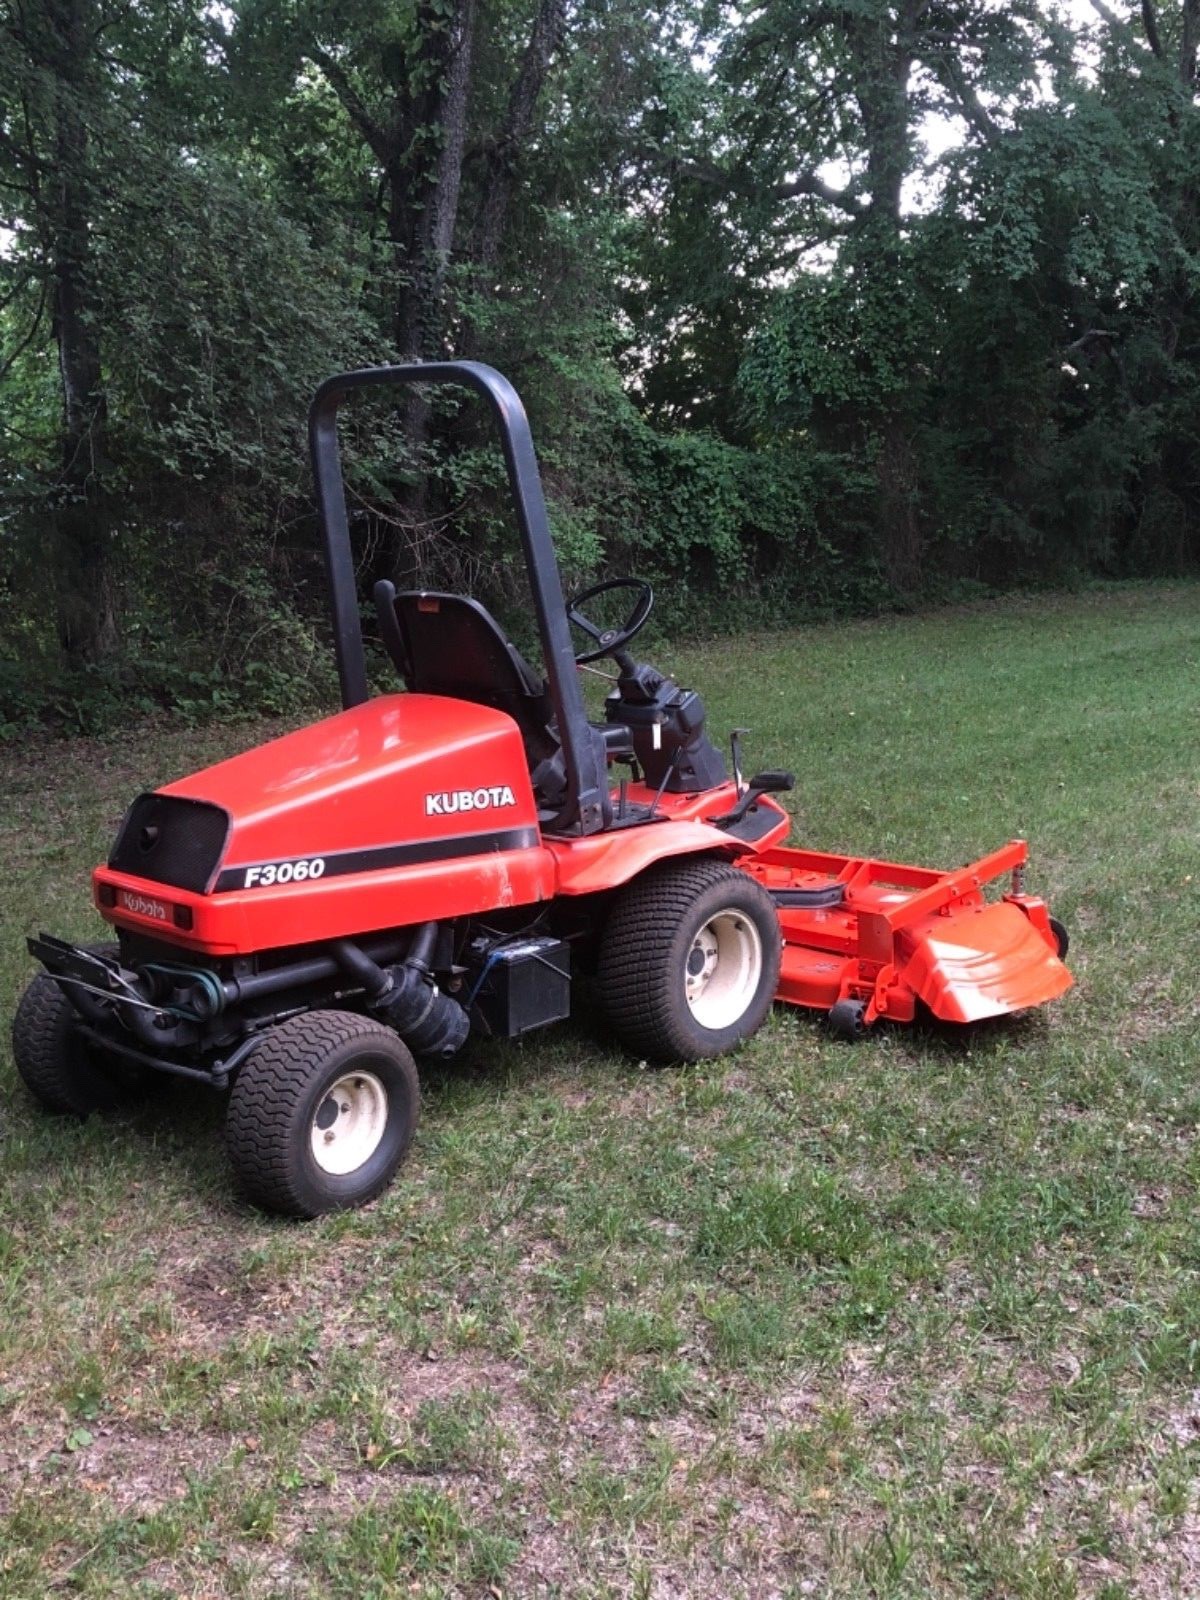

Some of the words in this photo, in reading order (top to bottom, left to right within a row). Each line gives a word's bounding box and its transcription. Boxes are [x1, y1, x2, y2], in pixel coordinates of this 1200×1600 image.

[425, 785, 516, 815] KUBOTA
[244, 858, 325, 888] F3060
[123, 891, 166, 920] Kubota
